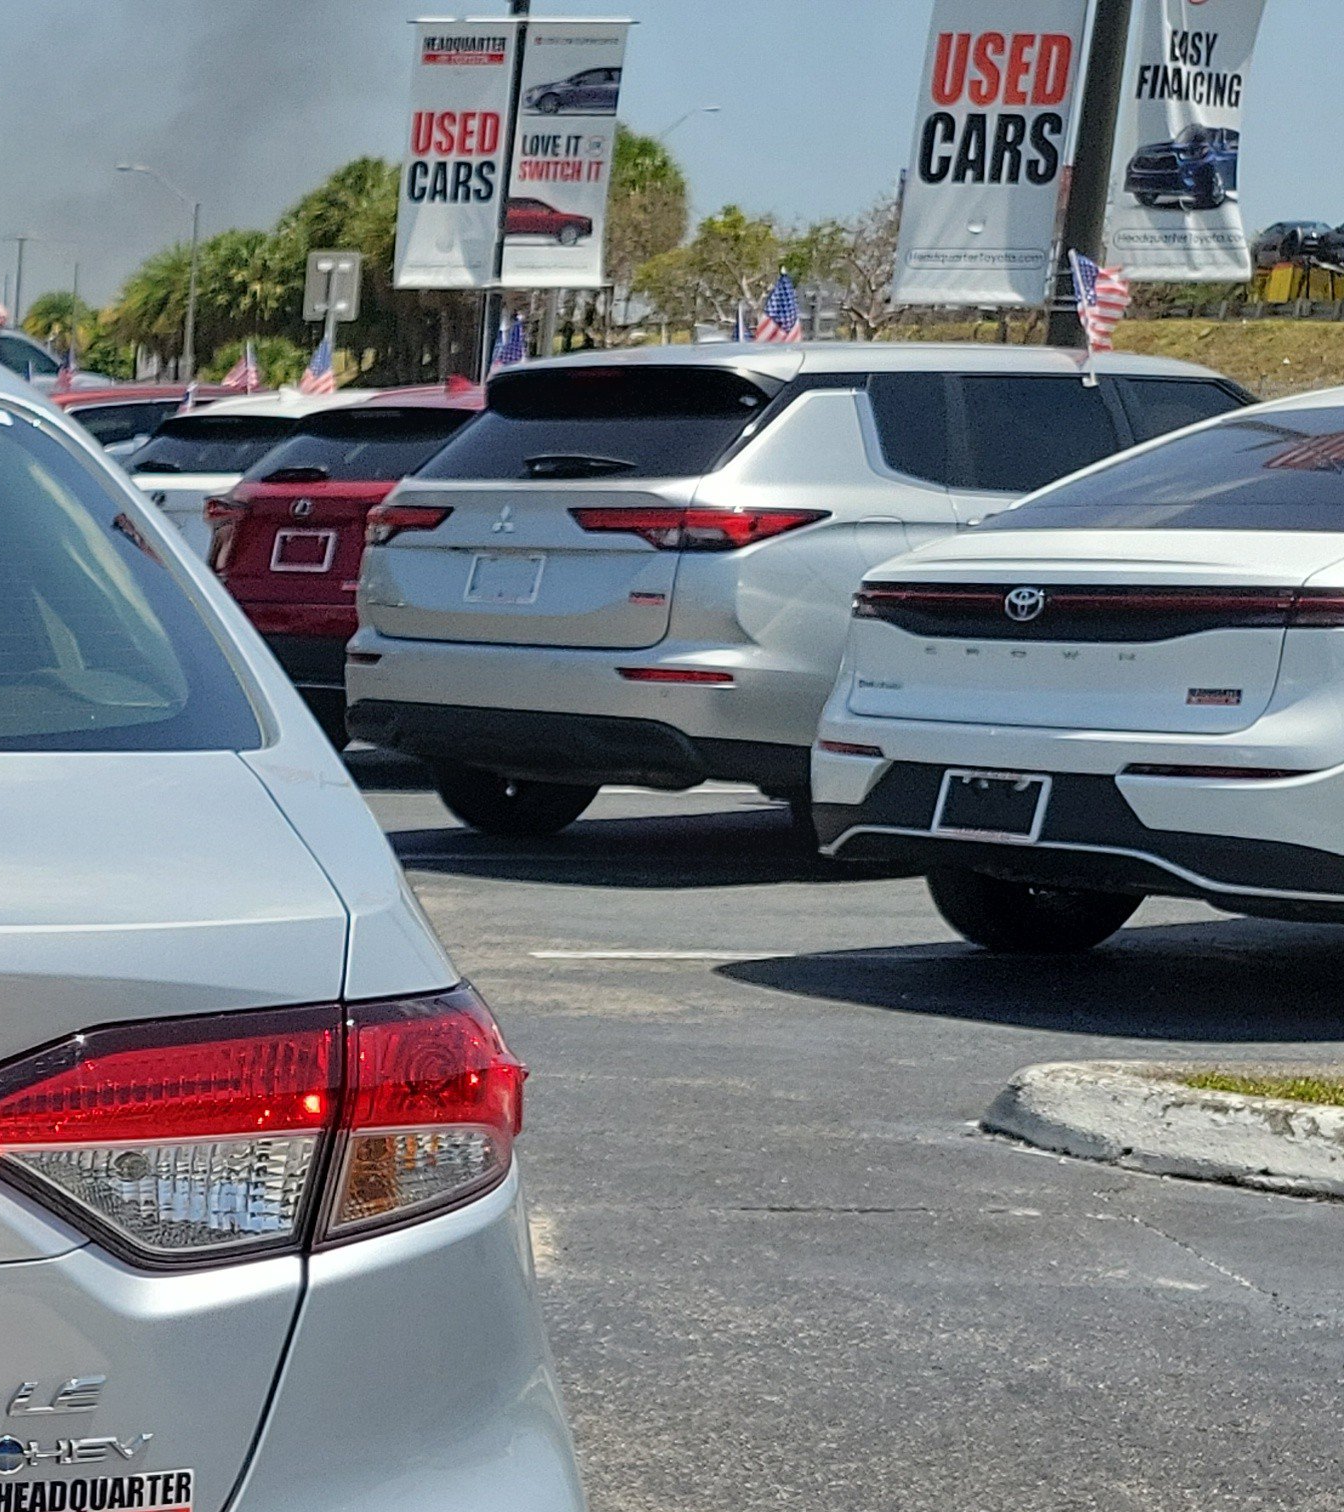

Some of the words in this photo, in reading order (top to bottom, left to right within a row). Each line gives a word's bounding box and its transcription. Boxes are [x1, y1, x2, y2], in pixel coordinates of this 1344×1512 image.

[931, 31, 1072, 107] USED
[1170, 30, 1218, 67] EASY
[411, 112, 501, 157] USED
[521, 135, 562, 157] LOVE
[564, 135, 583, 157] IT
[918, 112, 1063, 185] CARS
[407, 160, 496, 203] CARS
[519, 161, 582, 182] SWITCH
[587, 161, 604, 182] IT
[7, 1374, 107, 1417] LE
